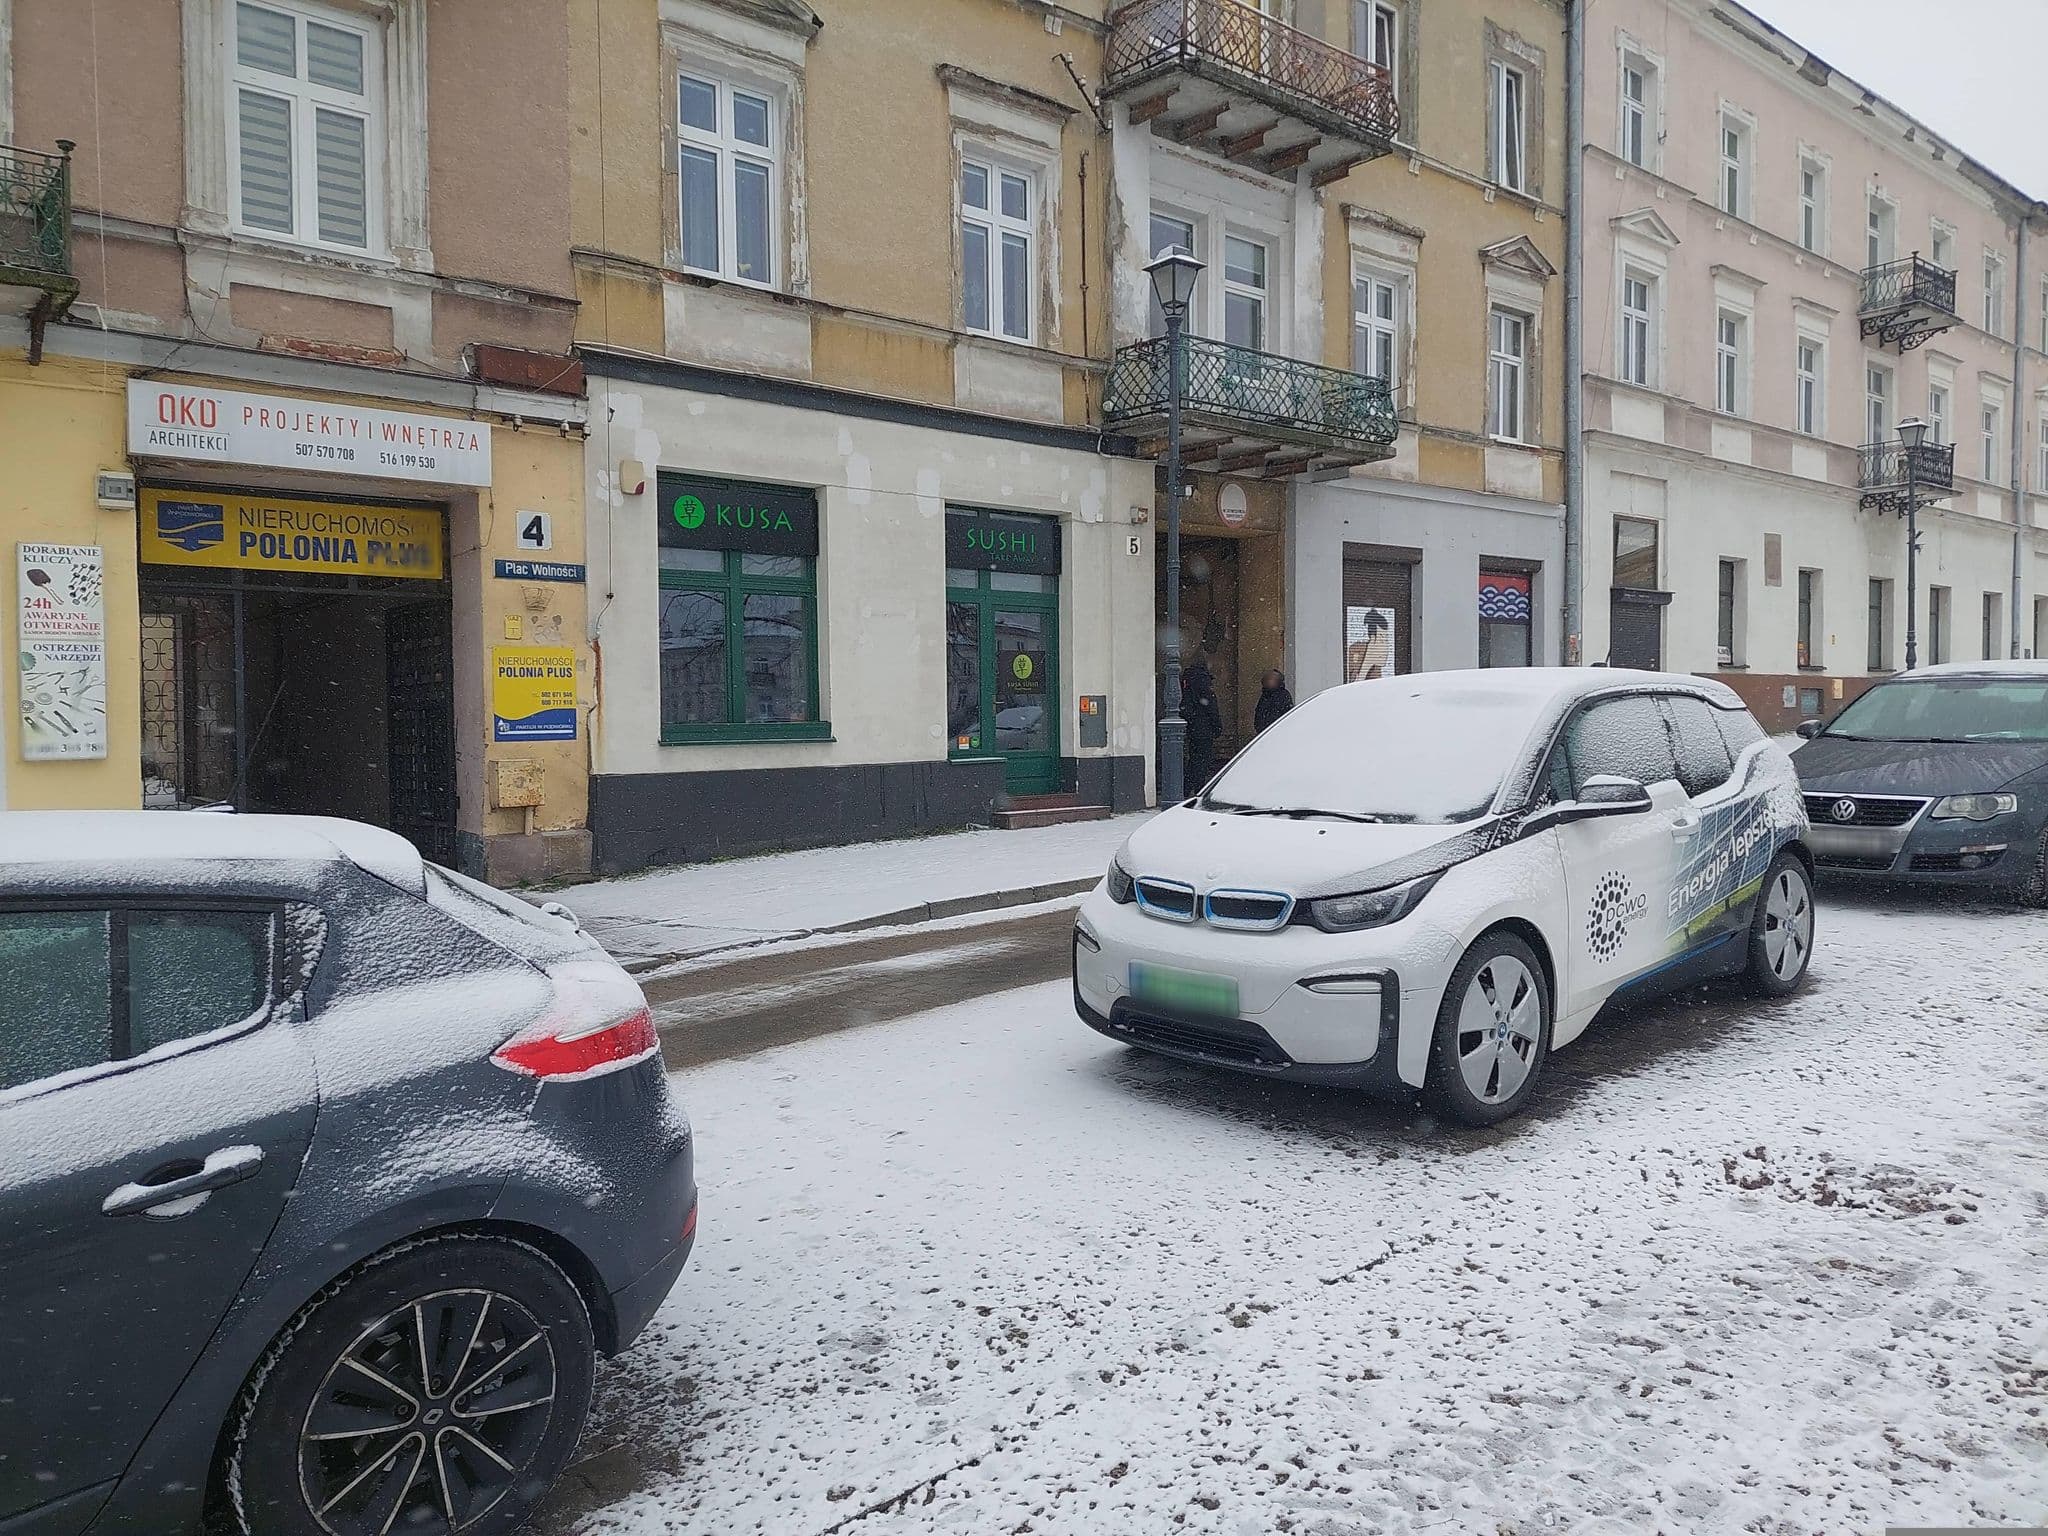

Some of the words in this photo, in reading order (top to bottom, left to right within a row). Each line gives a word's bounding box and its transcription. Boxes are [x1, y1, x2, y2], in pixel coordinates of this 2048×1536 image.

[159, 393, 217, 428] OKO
[243, 406, 359, 438] PROJEKTY
[367, 420, 373, 440] I
[381, 422, 480, 452] WNĘTRZA
[149, 430, 228, 451] ARCHITEKCI
[295, 443, 314, 457] 507
[316, 446, 335, 459] 570
[336, 448, 355, 462] 708
[379, 452, 398, 466] 516
[399, 454, 417, 467] 199
[418, 456, 436, 470] 530
[717, 503, 794, 532] KUSA
[522, 515, 545, 547] 4
[239, 531, 359, 564] POLONIA
[967, 527, 1035, 554] SUSHI
[1130, 537, 1139, 555] 5
[23, 545, 100, 557] DORABIANIE
[23, 555, 73, 565] KLUCZY
[505, 562, 529, 575] Plac
[532, 563, 578, 578] Wolności
[24, 597, 52, 609] 24h
[24, 612, 88, 621] AWARYJNE
[24, 621, 101, 631] OTWIERANIE
[33, 643, 102, 653] OSTRZENIE
[45, 653, 101, 663] NARZĘDZI
[498, 656, 573, 666] NIERUCHOMOŚCI
[498, 666, 545, 678] POLONIA
[546, 667, 573, 678] PLUS
[1668, 849, 1729, 918] Energia
[1605, 893, 1647, 928] pcwo
